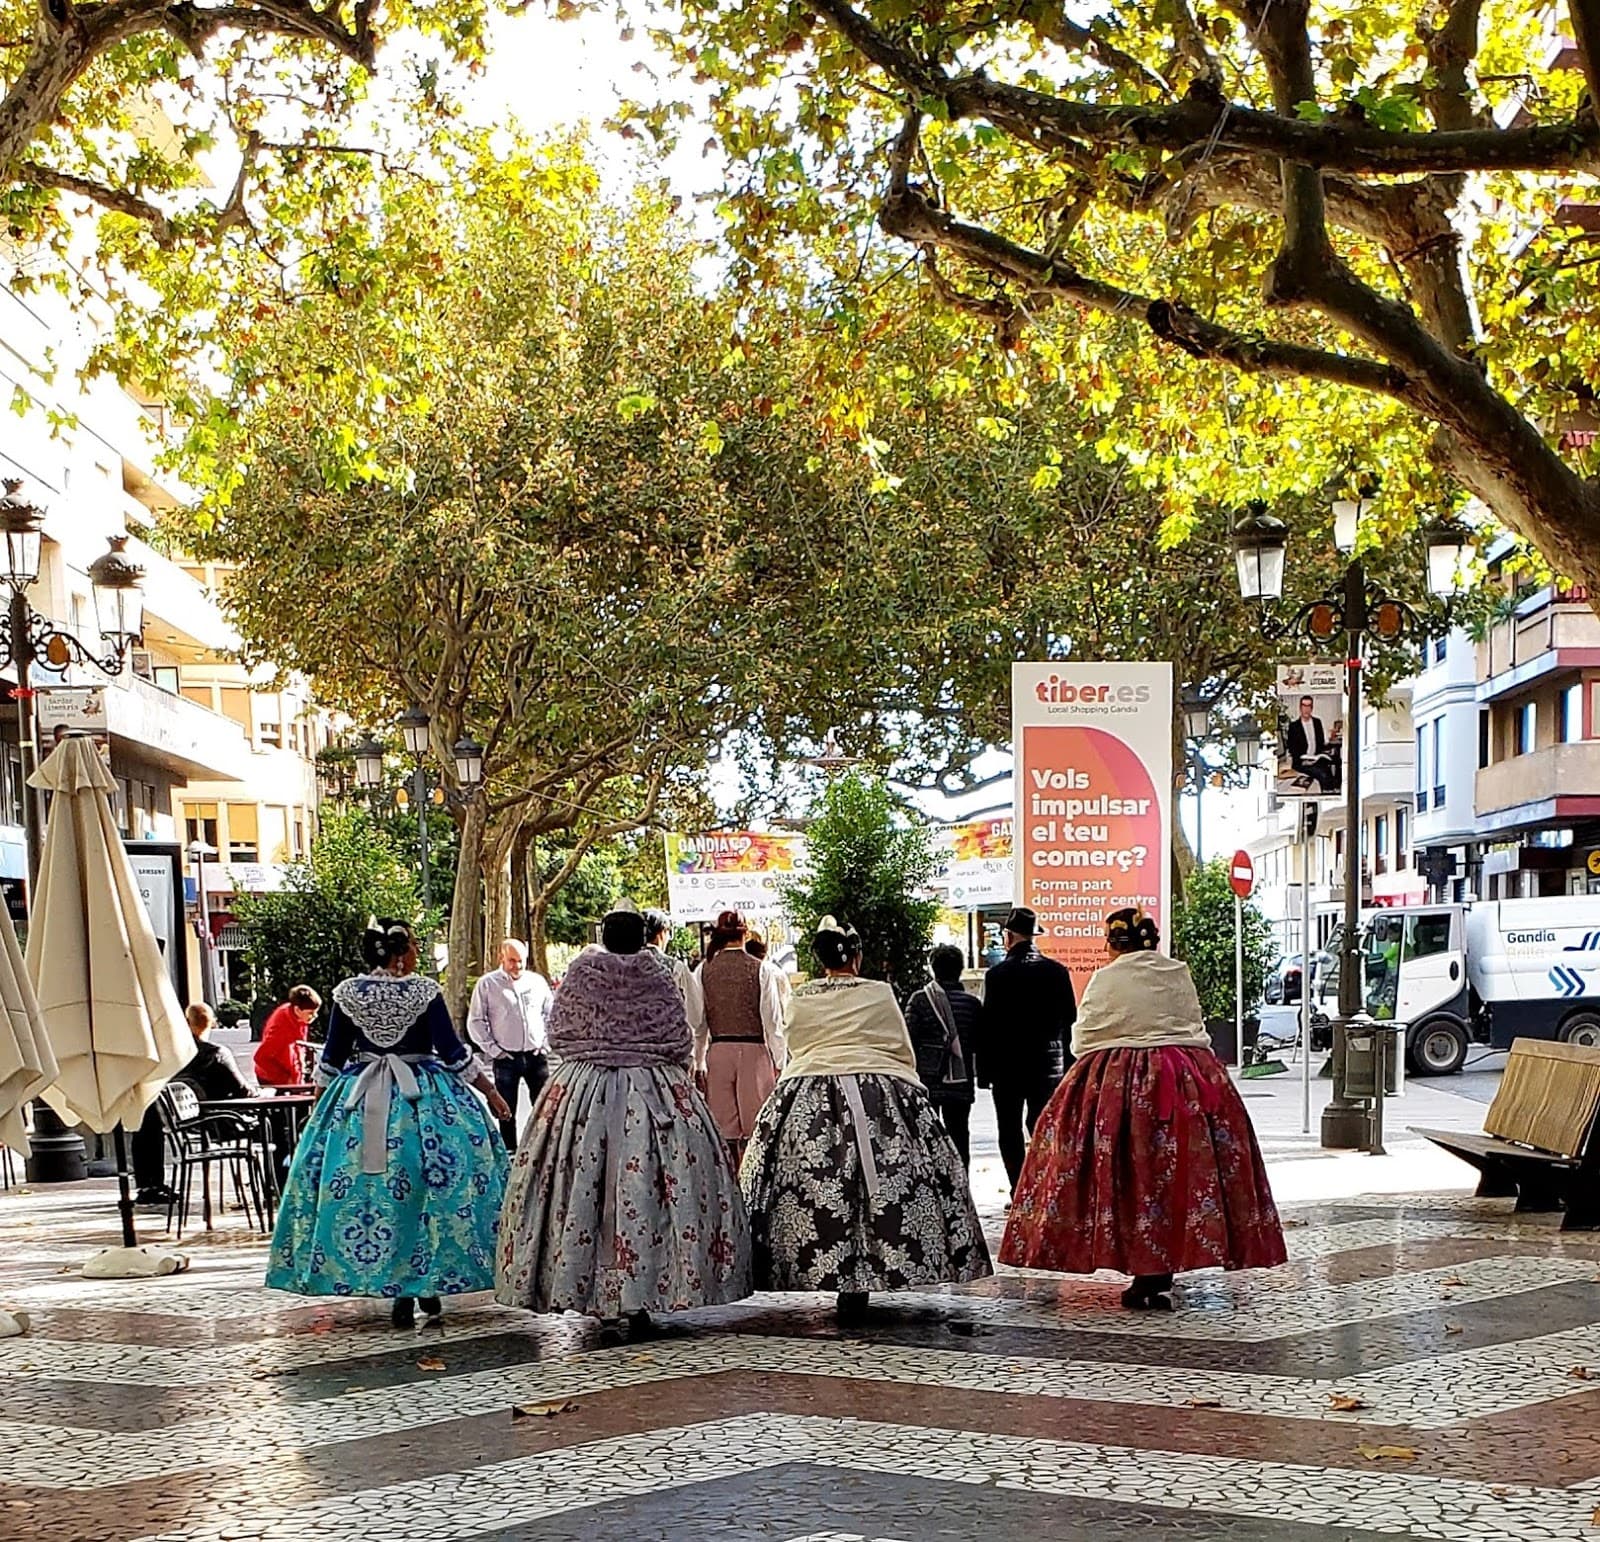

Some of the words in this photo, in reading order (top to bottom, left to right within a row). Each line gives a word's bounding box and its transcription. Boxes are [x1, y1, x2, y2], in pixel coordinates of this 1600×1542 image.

[1036, 675, 1150, 703] tiber.es
[1048, 706, 1069, 714] Local
[1070, 706, 1109, 715] Shopping
[1110, 705, 1138, 713] Gandia
[1031, 768, 1090, 790] Vols
[1031, 793, 1150, 820] impulsar
[1032, 821, 1057, 842] el
[1063, 823, 1109, 842] teu
[679, 836, 729, 853] GANDIA
[1032, 845, 1147, 873] comerç?
[1031, 879, 1079, 891] Forma
[1081, 879, 1113, 893] part
[1031, 894, 1055, 906] del
[1057, 894, 1107, 909] primer
[1110, 895, 1158, 907] centre
[1053, 924, 1105, 938] Gandia
[1507, 930, 1556, 944] Gandia
